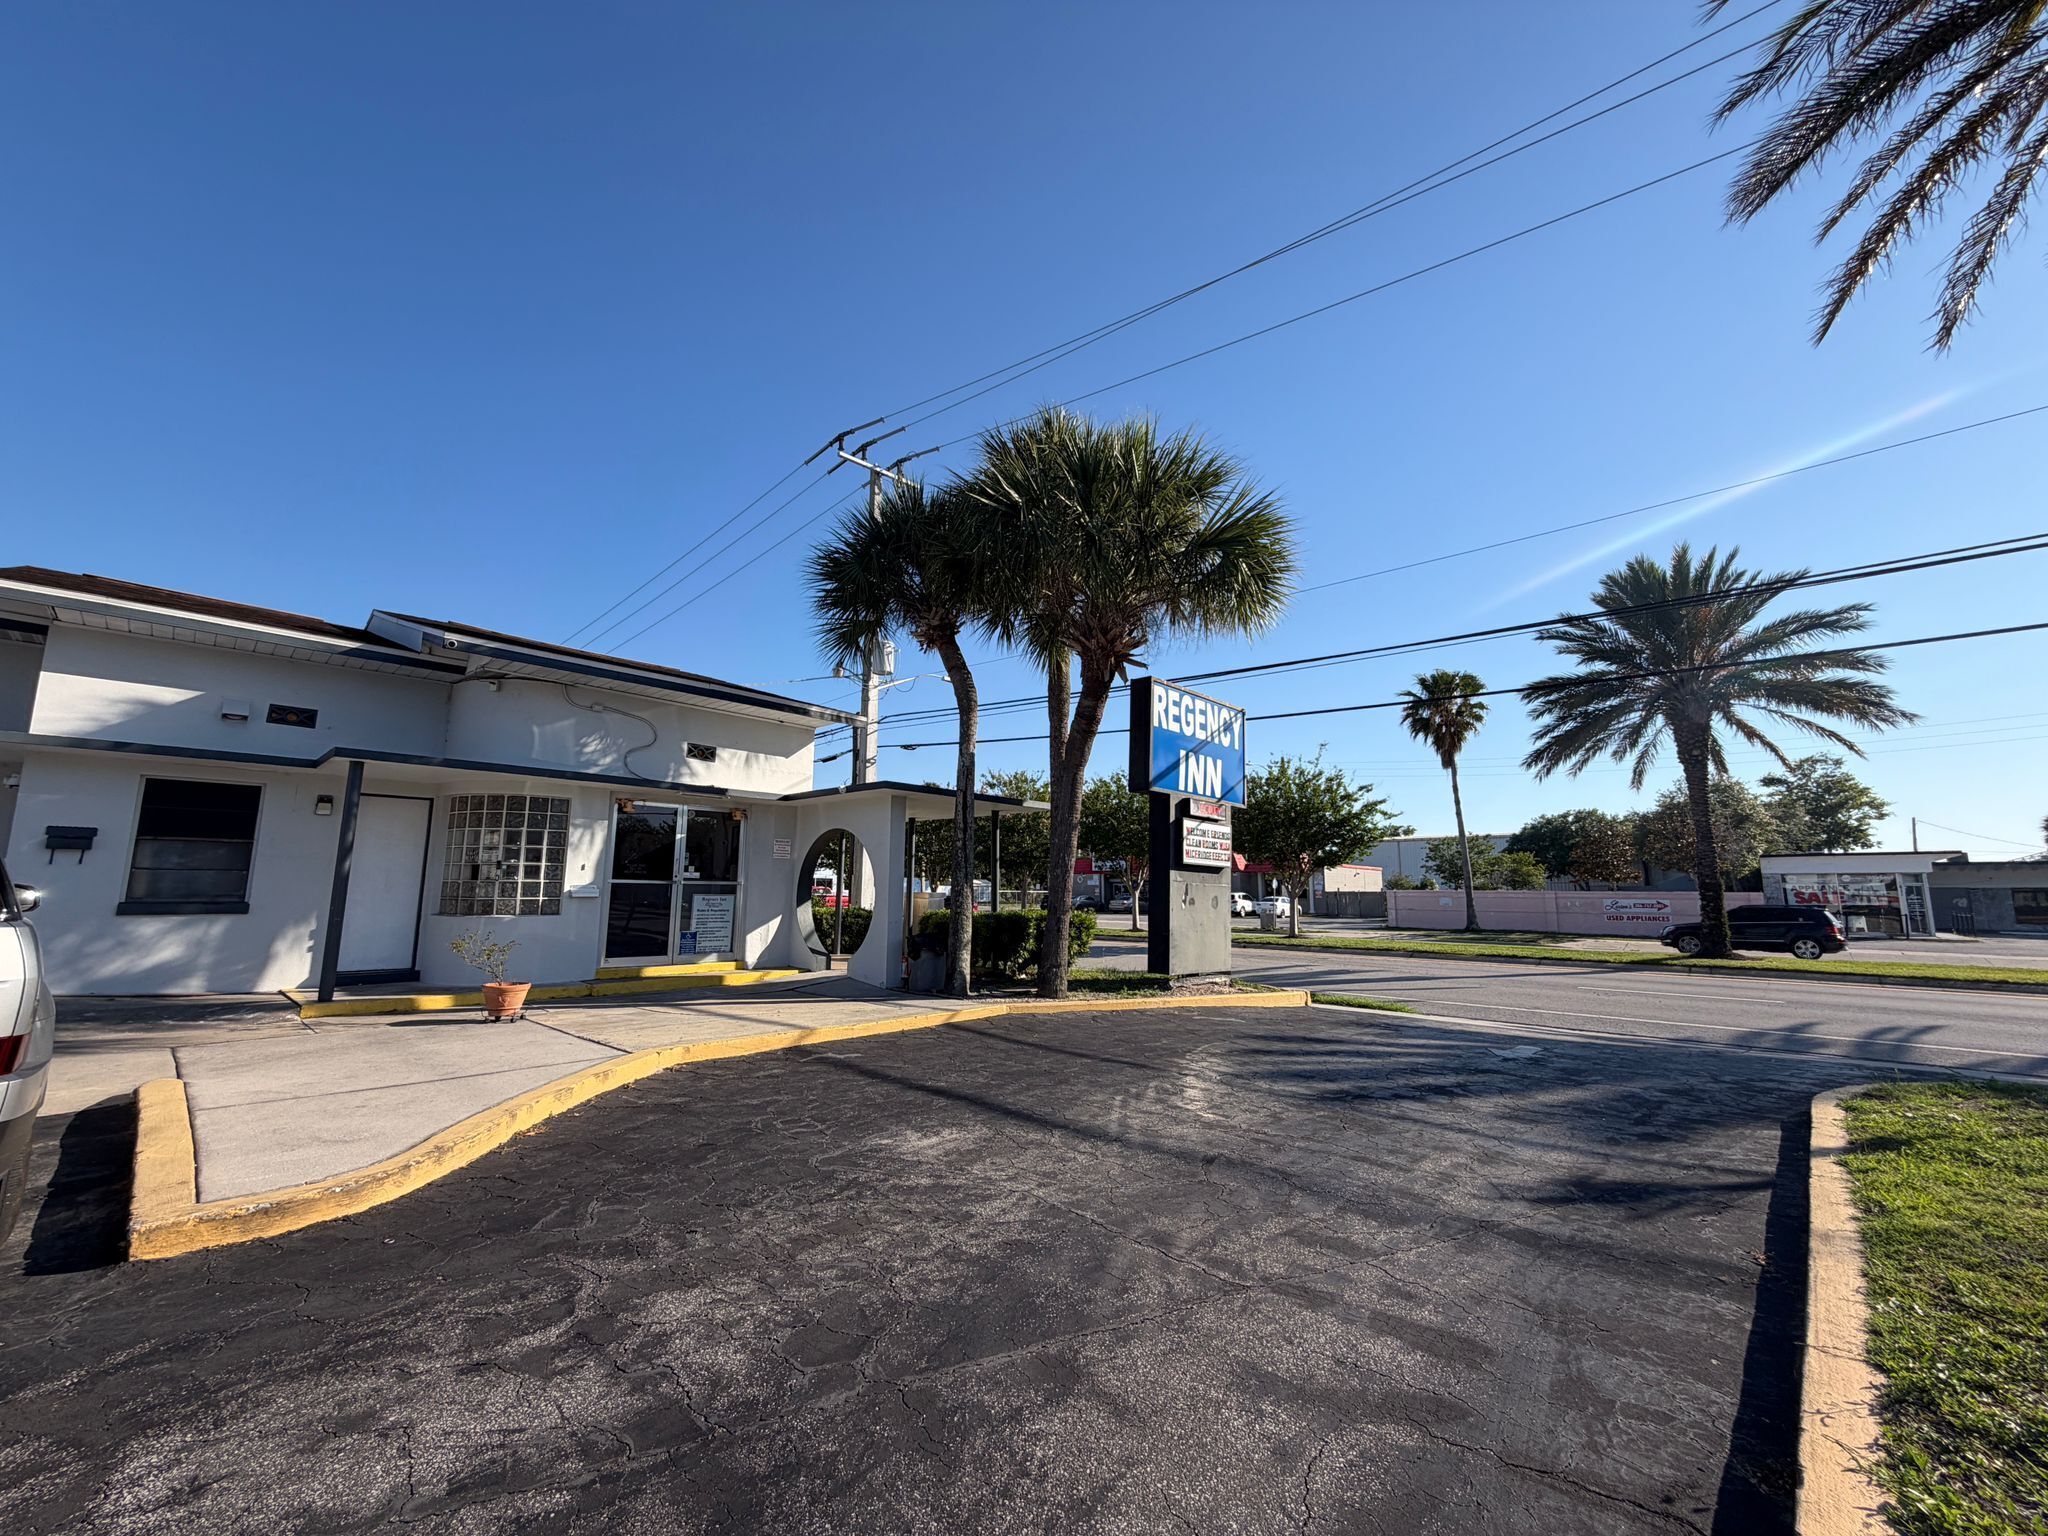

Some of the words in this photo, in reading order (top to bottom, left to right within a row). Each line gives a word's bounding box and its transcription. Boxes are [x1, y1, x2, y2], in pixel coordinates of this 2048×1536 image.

[1153, 684, 1242, 751] REGENCY
[1178, 749, 1222, 799] INN
[1186, 827, 1211, 838] WELCOME
[1186, 838, 1201, 848] CLEAN
[1202, 840, 1218, 850] ROOMS
[1794, 890, 1846, 905] SALE
